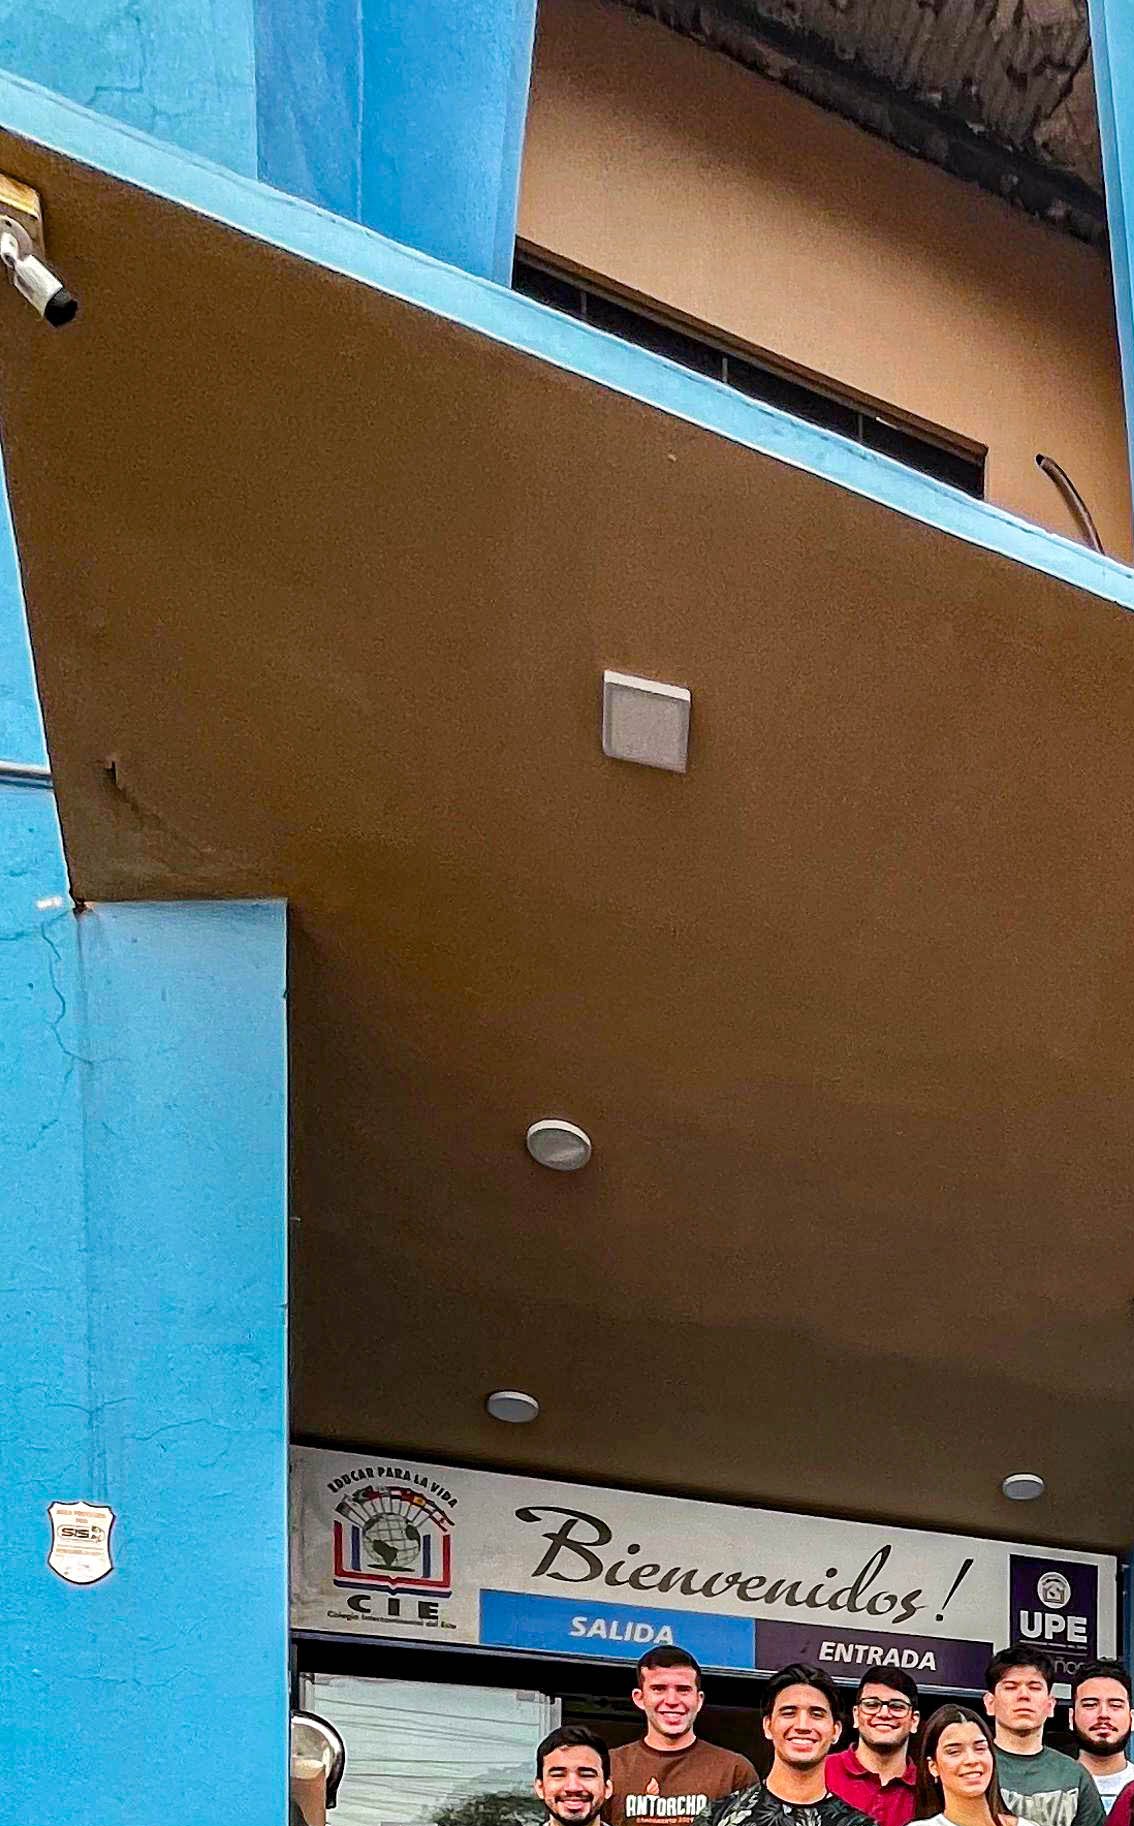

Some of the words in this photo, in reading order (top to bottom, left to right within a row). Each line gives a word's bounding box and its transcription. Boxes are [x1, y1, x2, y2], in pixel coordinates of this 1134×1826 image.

[328, 1467, 374, 1493] EDUCAR
[377, 1466, 411, 1481] PARA
[414, 1474, 428, 1488] LA
[430, 1482, 458, 1508] VIDA
[347, 1594, 439, 1619] CIE
[568, 1616, 673, 1646] SALIDA
[1020, 1610, 1088, 1643] UPE
[819, 1641, 937, 1671] ENTRADA
